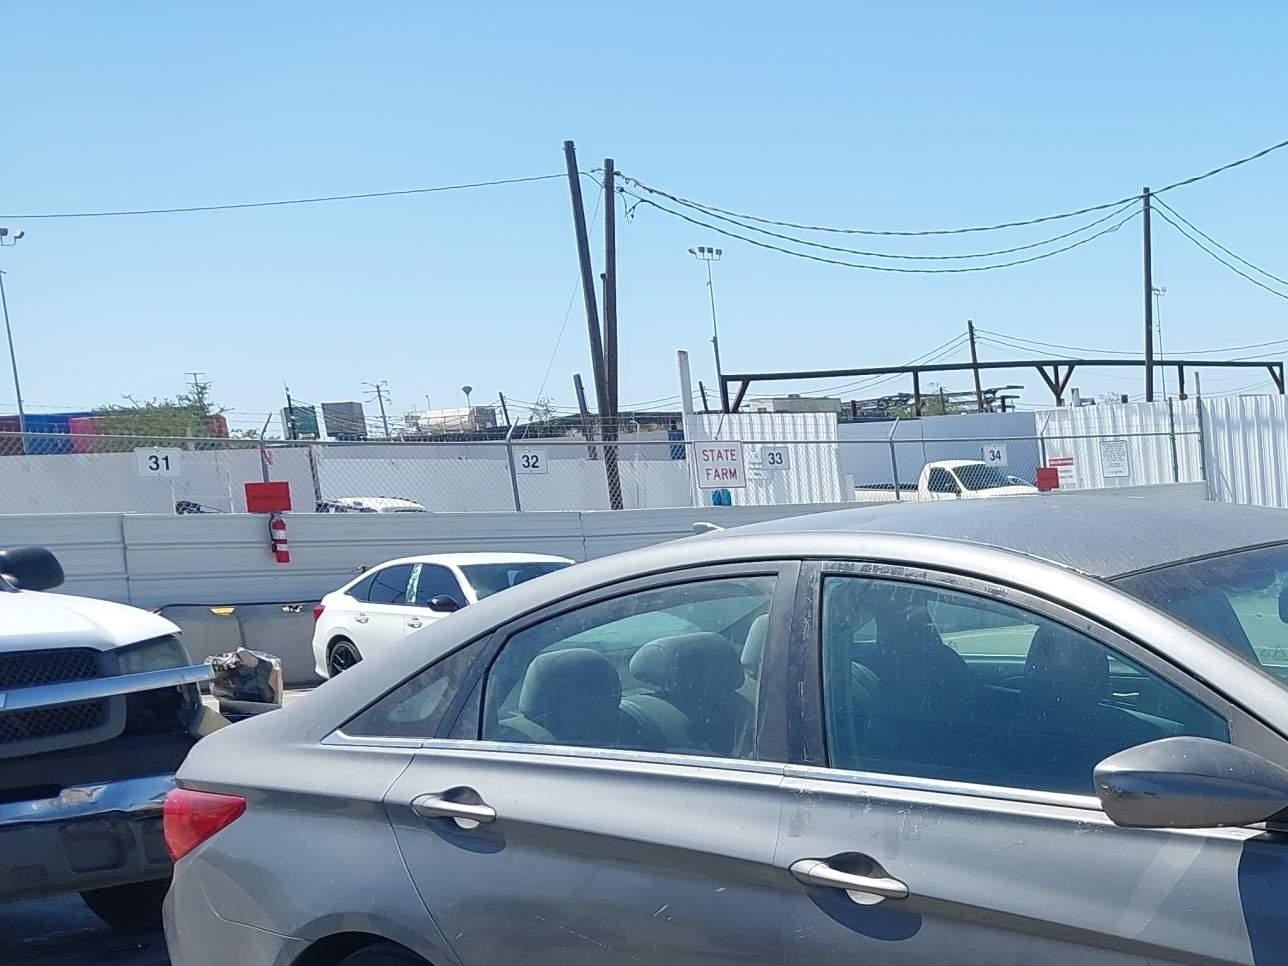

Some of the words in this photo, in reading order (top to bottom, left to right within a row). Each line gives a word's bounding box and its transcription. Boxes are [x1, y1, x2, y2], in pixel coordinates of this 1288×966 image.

[702, 449, 737, 461] STATE
[768, 452, 783, 464] 33
[989, 450, 1001, 461] 34
[148, 455, 170, 471] 31
[521, 454, 540, 469] 32
[705, 468, 738, 480] FARM
